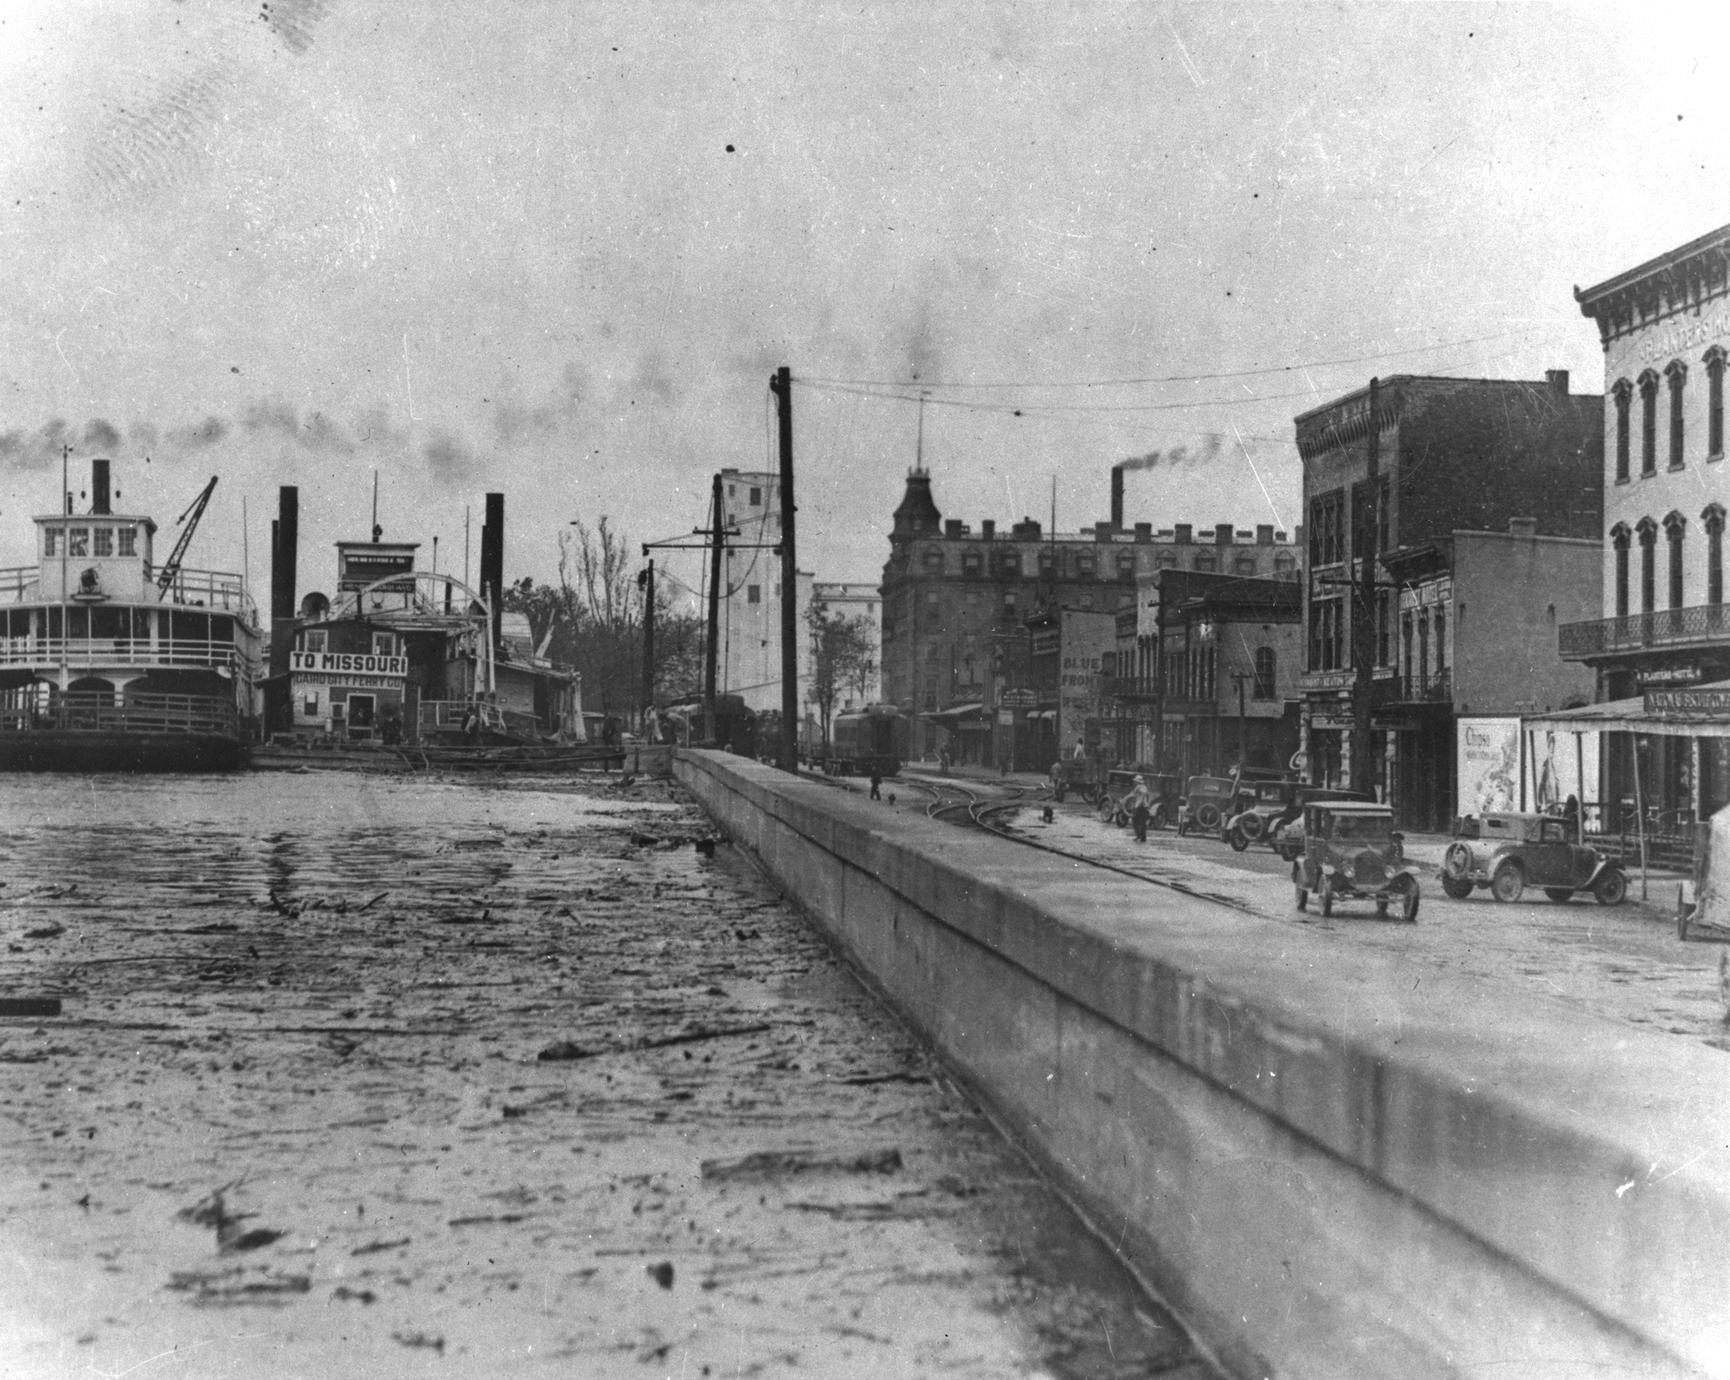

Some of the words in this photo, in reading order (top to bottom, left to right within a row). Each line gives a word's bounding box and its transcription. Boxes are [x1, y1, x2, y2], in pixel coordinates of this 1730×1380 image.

[293, 653, 315, 669] TO
[322, 655, 405, 673] MISSOURI
[1063, 657, 1101, 669] BLUE
[328, 674, 350, 685] CITY
